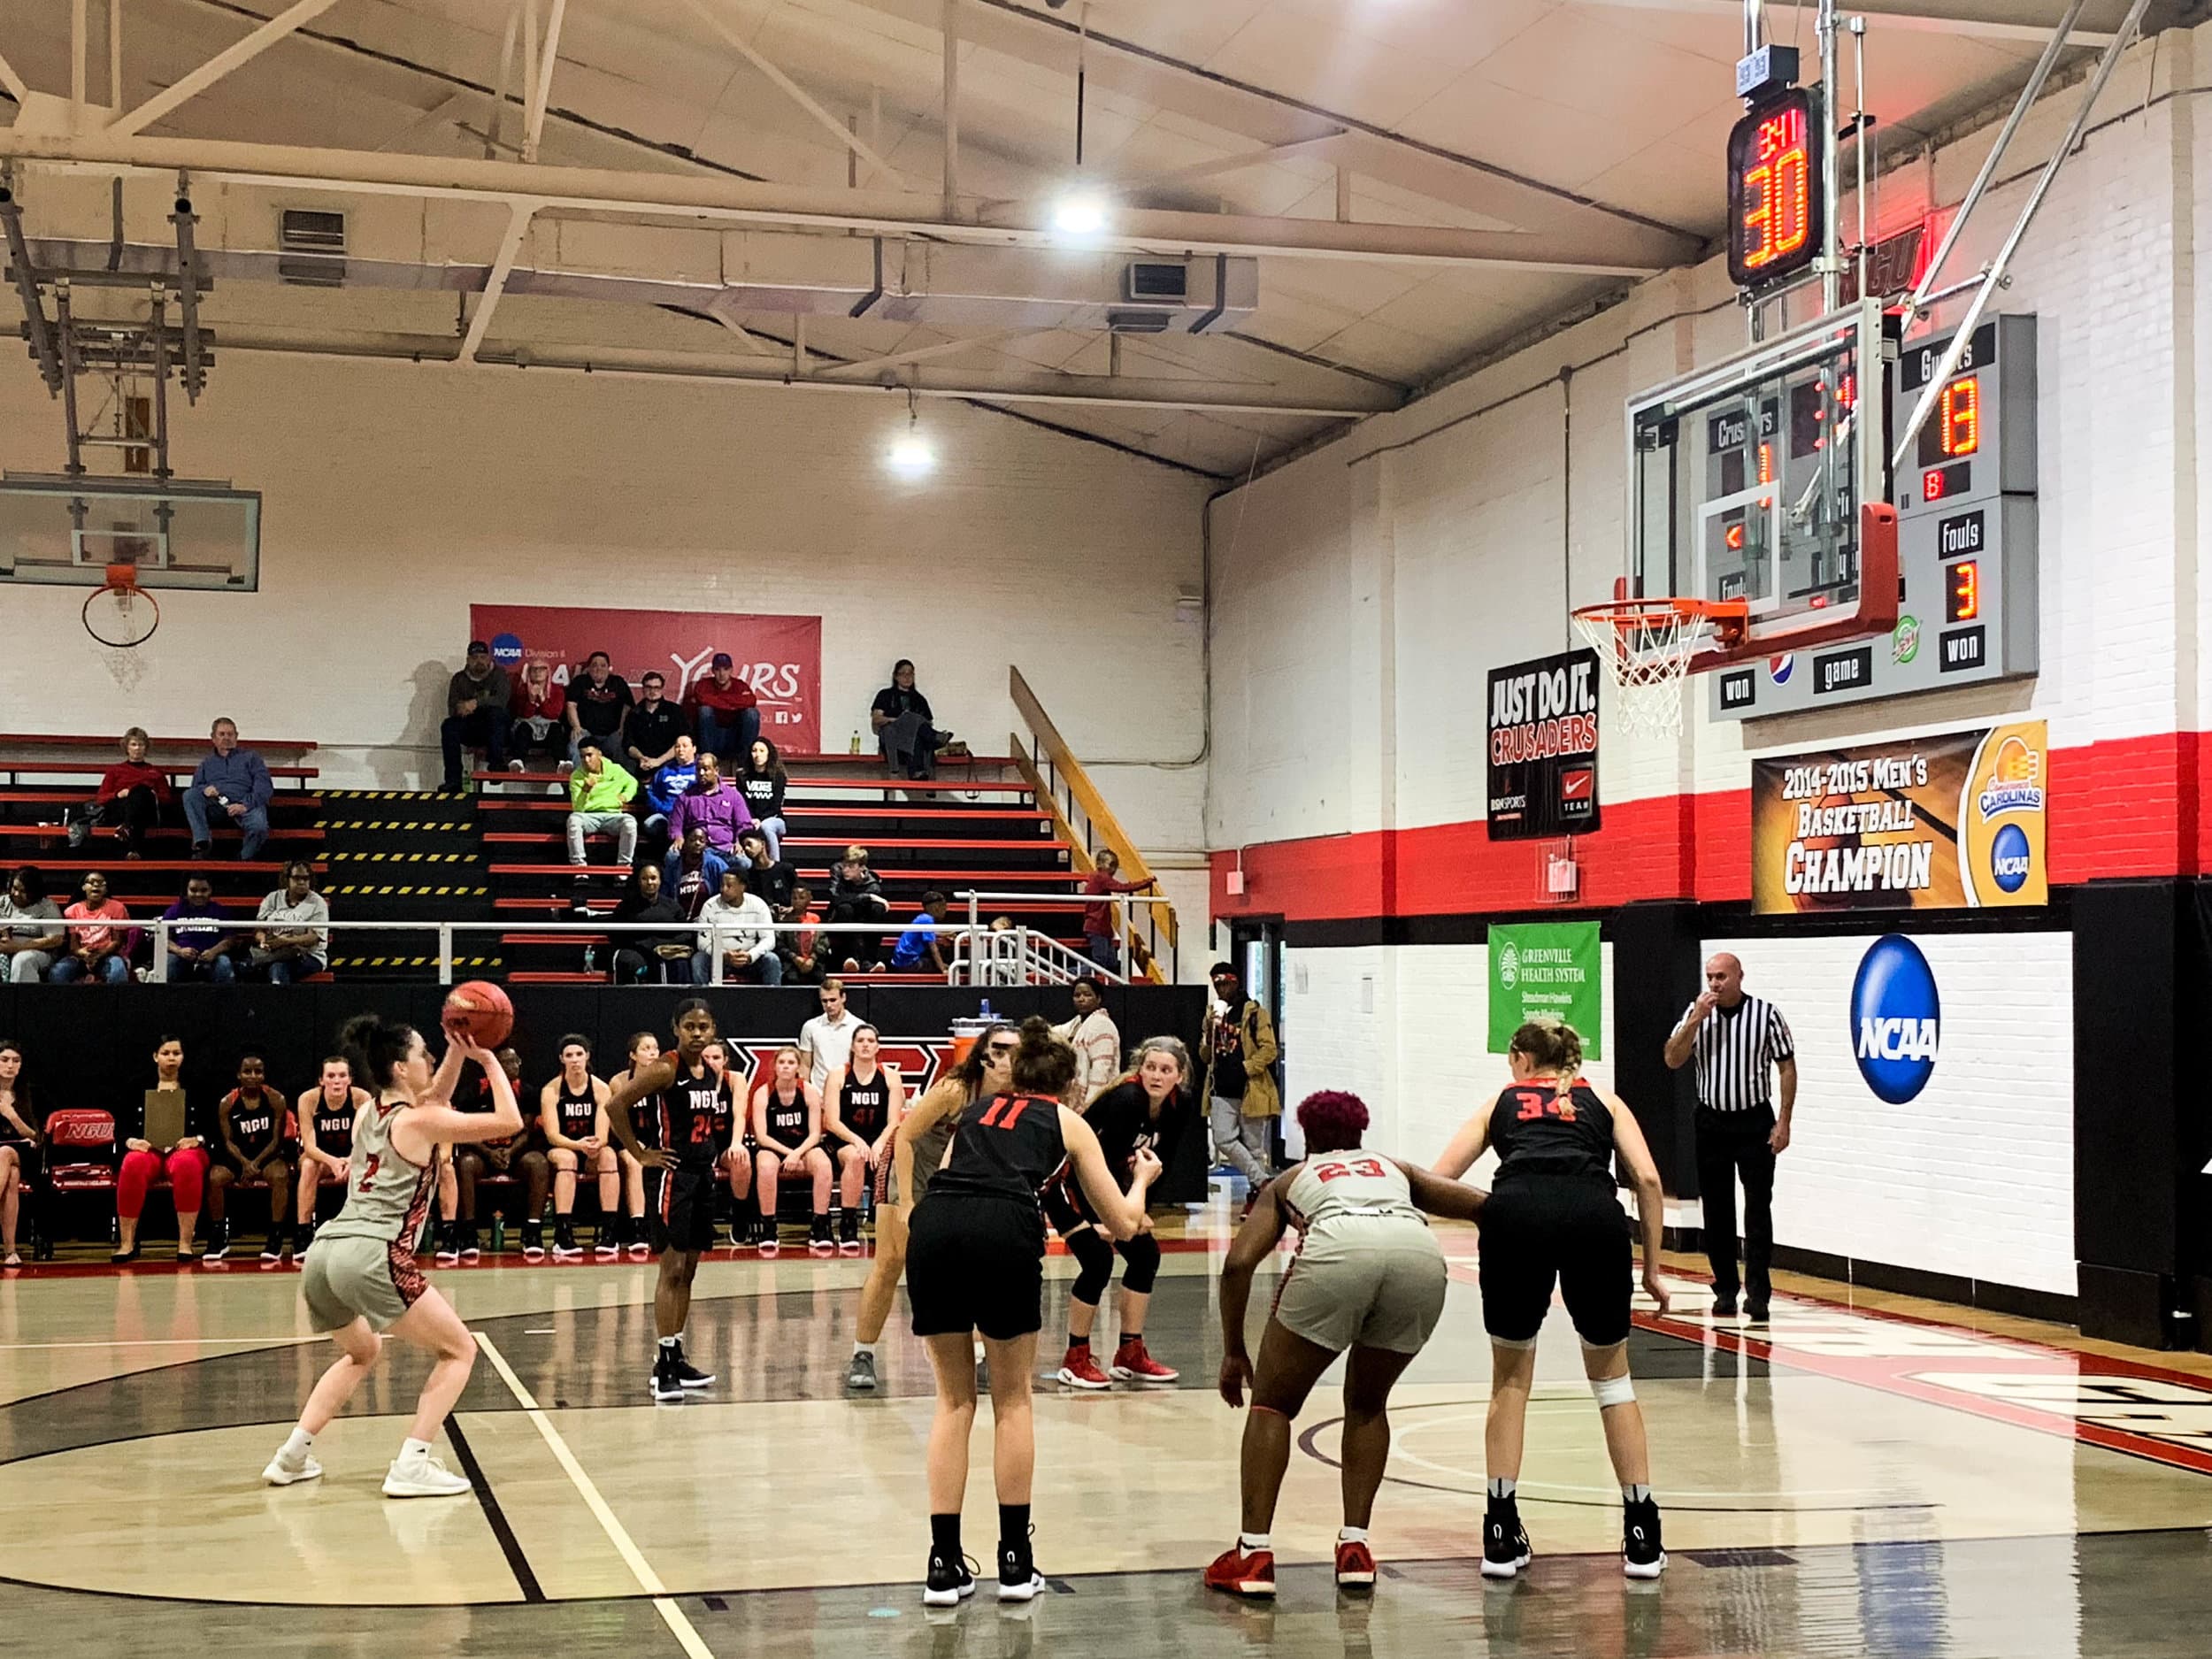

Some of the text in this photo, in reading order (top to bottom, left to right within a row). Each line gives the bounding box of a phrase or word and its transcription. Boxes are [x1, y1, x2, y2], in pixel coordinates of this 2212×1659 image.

[1744, 148, 1808, 267] 30
[1941, 378, 1976, 454] 13
[1943, 518, 1978, 554] fouls
[1955, 563, 1975, 618] 3
[1947, 635, 1978, 663] won
[1725, 676, 1749, 702] won
[1824, 656, 1859, 690] game
[1491, 661, 1596, 727] JUST DO IT.
[1491, 712, 1597, 766] CRUSADERS
[1783, 760, 1870, 800] 2014-2015
[1980, 789, 2040, 812] CAROLINAS
[1797, 799, 1916, 839] BASKETBALL
[1785, 841, 1932, 895] CHAMPION
[1994, 856, 2029, 877] NCAA
[1522, 949, 1572, 964] GREENVILLE
[1521, 967, 1586, 983] HEALTH SYSTEM
[1858, 1017, 1939, 1063] NCAA
[565, 1102, 592, 1117] NGU
[851, 1092, 879, 1105] NGU
[978, 1096, 1029, 1131] 11
[240, 1117, 269, 1134] NGU
[320, 1118, 350, 1132] NGU
[776, 1111, 802, 1126] NGU
[357, 1152, 380, 1193] 2
[1313, 1158, 1387, 1184] 23
